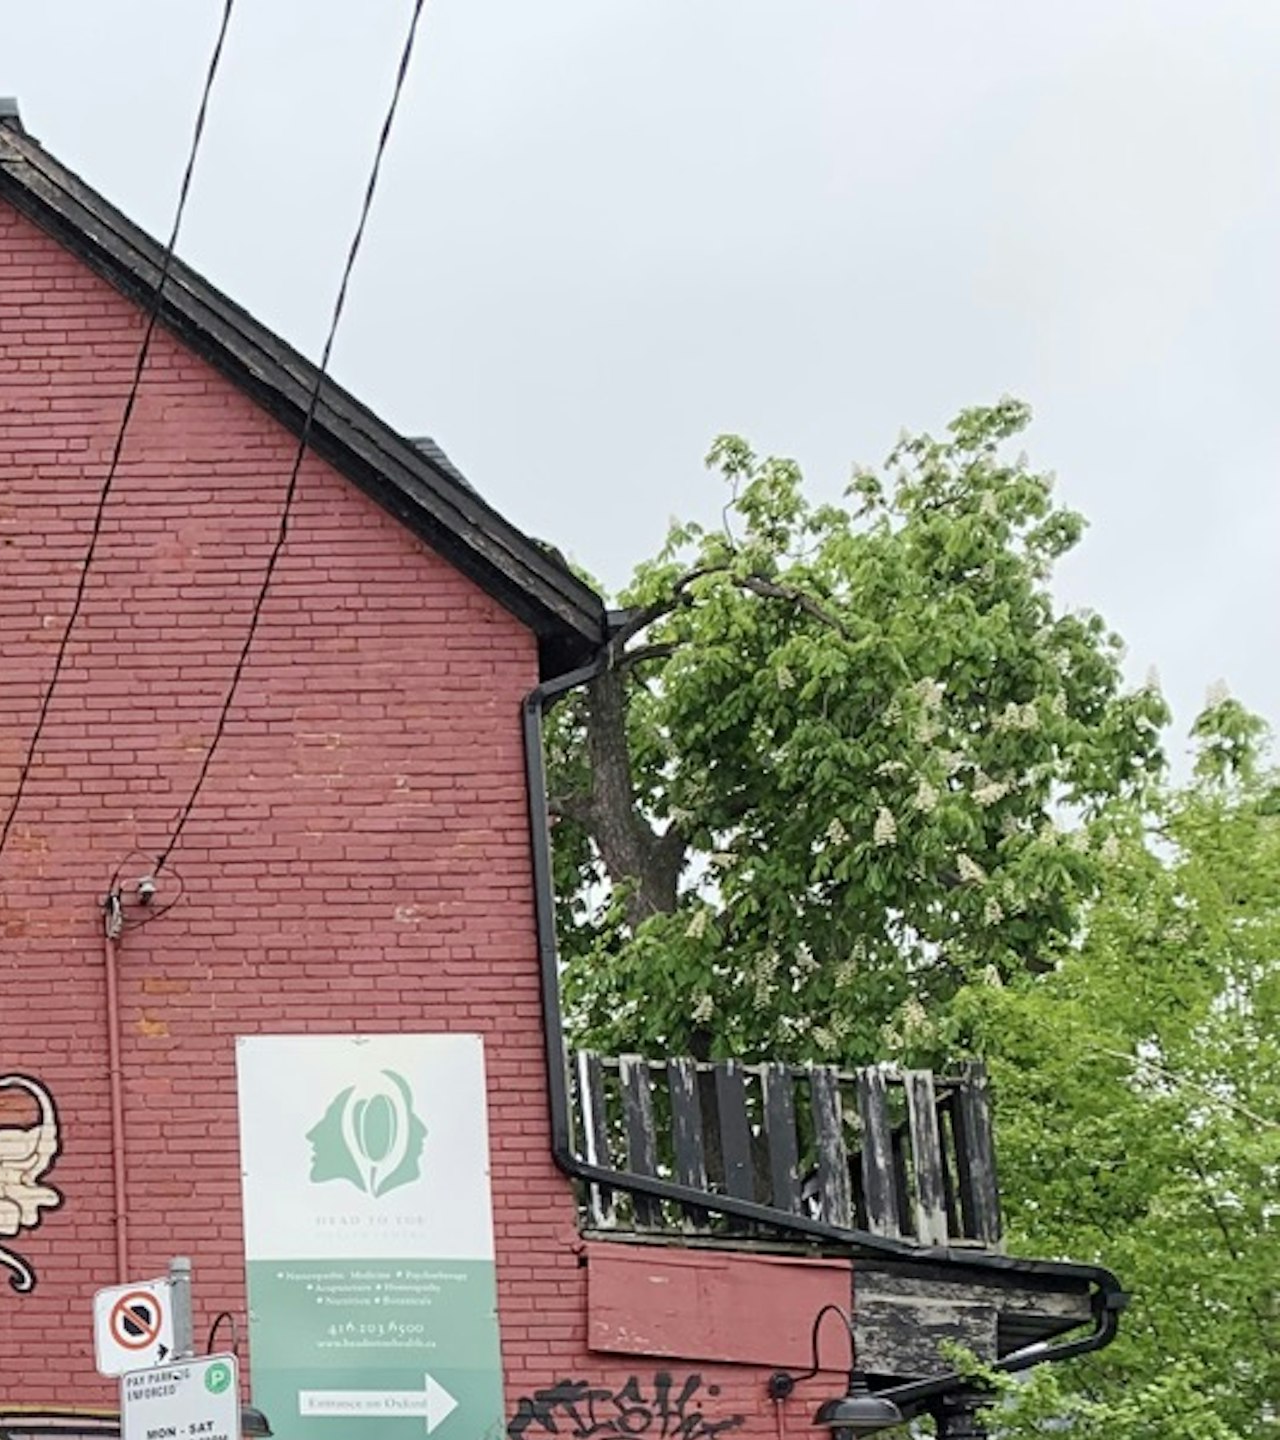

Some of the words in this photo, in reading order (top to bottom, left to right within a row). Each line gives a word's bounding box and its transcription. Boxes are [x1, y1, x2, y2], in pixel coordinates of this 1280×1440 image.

[316, 1215, 361, 1226] HEAD
[369, 1215, 389, 1226] TO
[350, 1270, 391, 1279] Medicine
[127, 1375, 145, 1388] PAY
[127, 1384, 176, 1402] ENFORCED
[308, 1397, 362, 1409] Entrance
[366, 1399, 382, 1408] on
[384, 1397, 428, 1408] Oxford
[146, 1426, 177, 1440] MON
[188, 1420, 215, 1435] SAT
